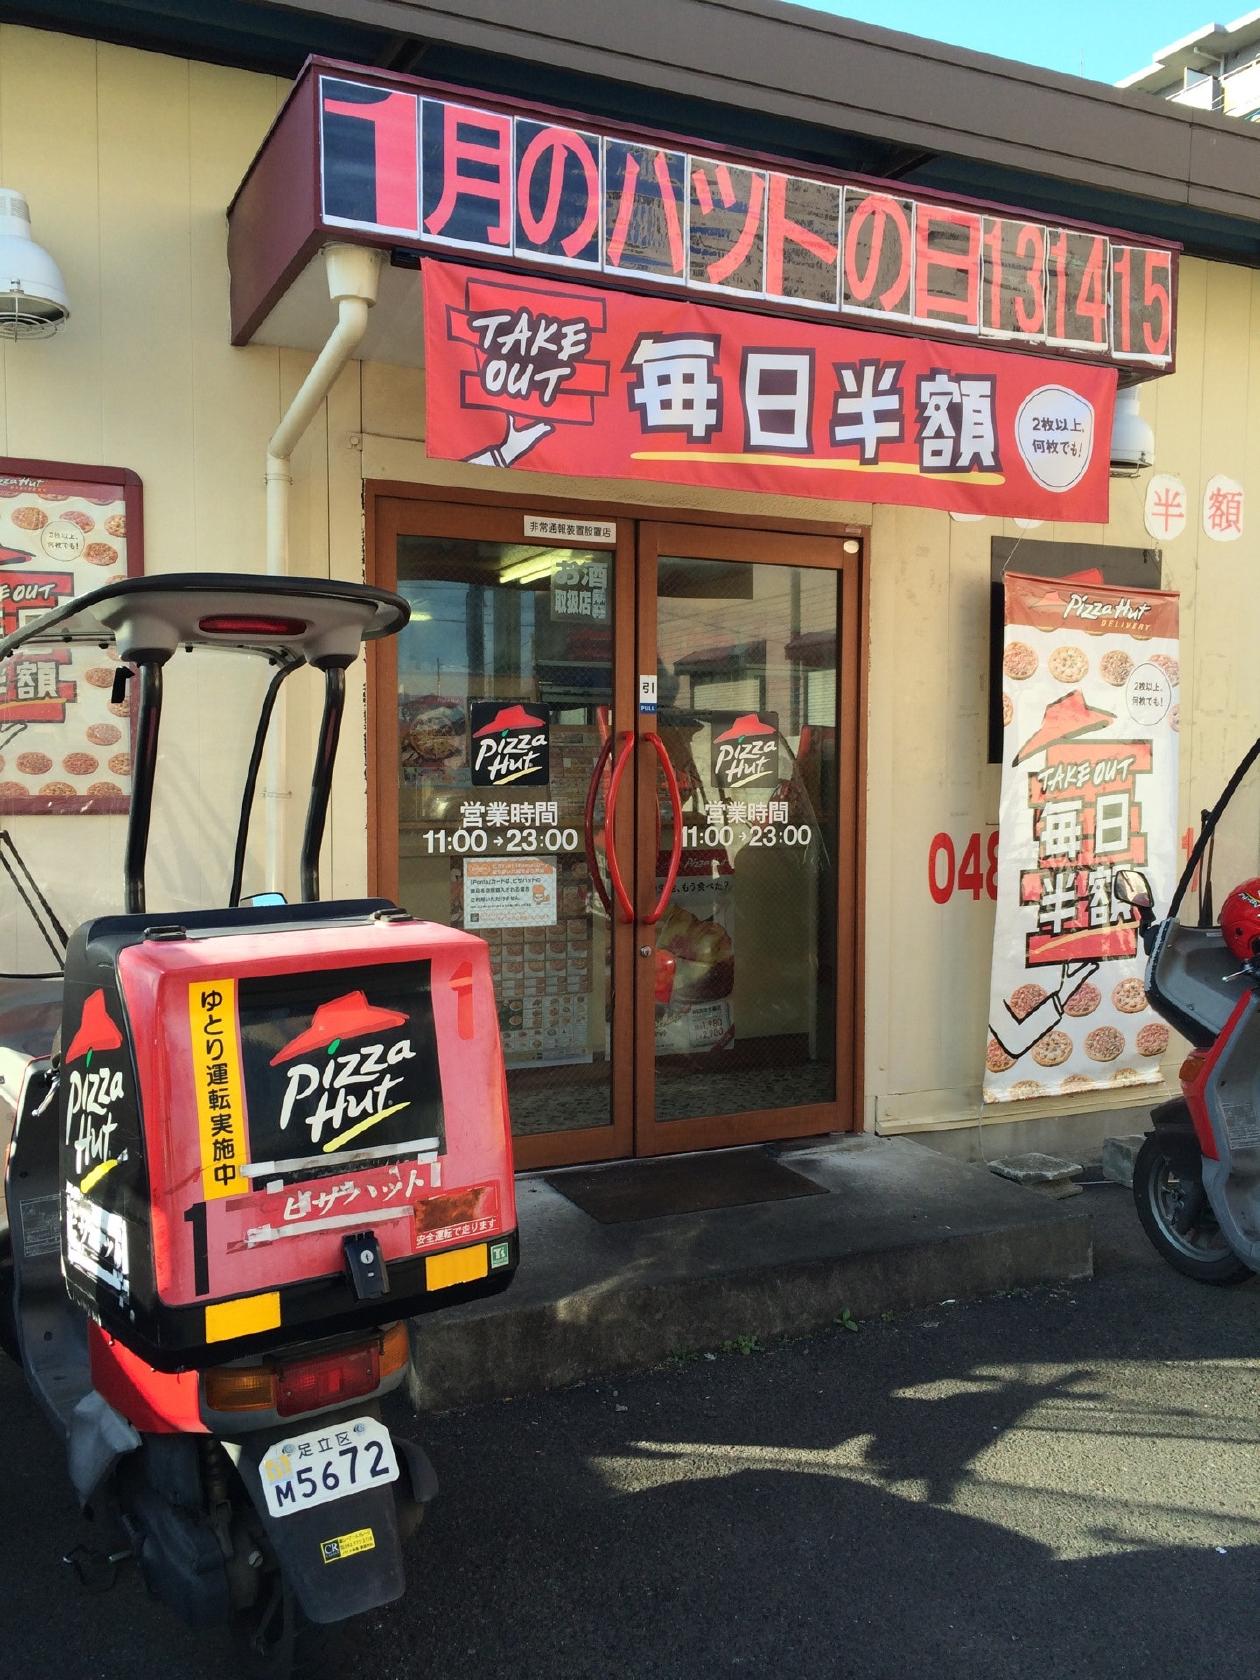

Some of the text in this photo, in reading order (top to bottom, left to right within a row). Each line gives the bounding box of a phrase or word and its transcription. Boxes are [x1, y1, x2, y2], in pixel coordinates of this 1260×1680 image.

[472, 312, 588, 361] TAKE
[485, 359, 571, 402] OUT
[631, 339, 997, 468] 毎日半額
[13, 583, 56, 601] OUT
[1063, 592, 1152, 621] Pizza Hut
[642, 681, 655, 695] 引
[640, 704, 656, 712] PULL
[475, 732, 548, 771] Pizza
[487, 751, 541, 781] Hut
[715, 739, 777, 774] Pizza
[725, 758, 770, 783] Hut
[1038, 757, 1137, 793] TAKE OUT
[460, 801, 558, 829] 営業時間
[704, 801, 789, 824] 営業時間
[1040, 793, 1130, 859] 毎日
[422, 828, 579, 854] 11:00 23:00
[749, 824, 812, 847] 23:00
[200, 989, 238, 1187] ゆとり運転実施中
[280, 1039, 416, 1131] Pizza
[66, 1066, 125, 1146] Pizza
[305, 1074, 405, 1144] Hut
[75, 1112, 118, 1175] Hut
[184, 1201, 210, 1297] 1
[416, 1217, 497, 1247] 安全運転で走ります
[298, 1431, 353, 1459] 足立区
